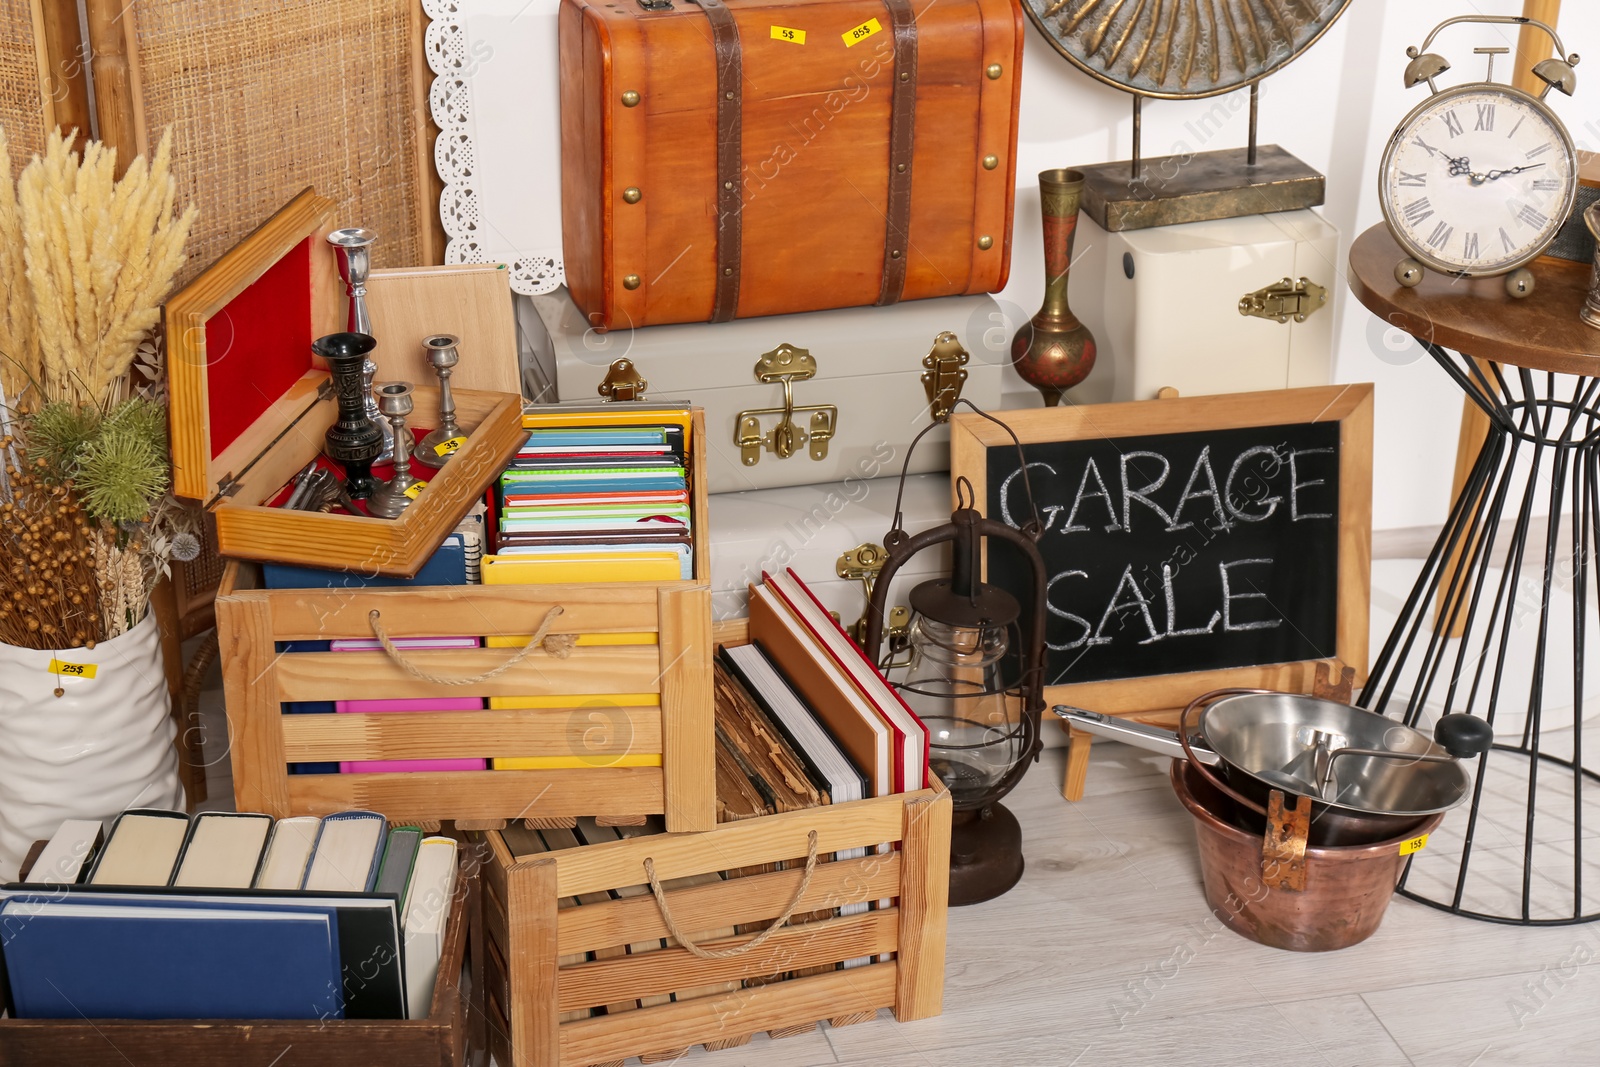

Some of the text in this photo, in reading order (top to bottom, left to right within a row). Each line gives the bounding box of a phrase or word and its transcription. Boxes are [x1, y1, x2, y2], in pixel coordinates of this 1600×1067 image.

[782, 29, 795, 40] 5$
[852, 25, 871, 39] 85$
[1439, 109, 1464, 139] XI
[1474, 103, 1496, 132] XII
[1507, 114, 1526, 139] I
[1411, 135, 1438, 157] X
[1525, 142, 1551, 160] II
[1398, 170, 1427, 187] IX
[1532, 179, 1559, 191] III
[1402, 196, 1435, 228] VIII
[1517, 204, 1549, 231] IIII
[1427, 220, 1454, 252] VII
[1463, 232, 1480, 259] VI
[1498, 226, 1517, 254] V
[443, 440, 459, 450] 3$
[1000, 444, 1335, 534] GARAGE
[1044, 557, 1283, 651] SALE
[61, 664, 84, 676] 25$
[1410, 838, 1422, 850] 15$
